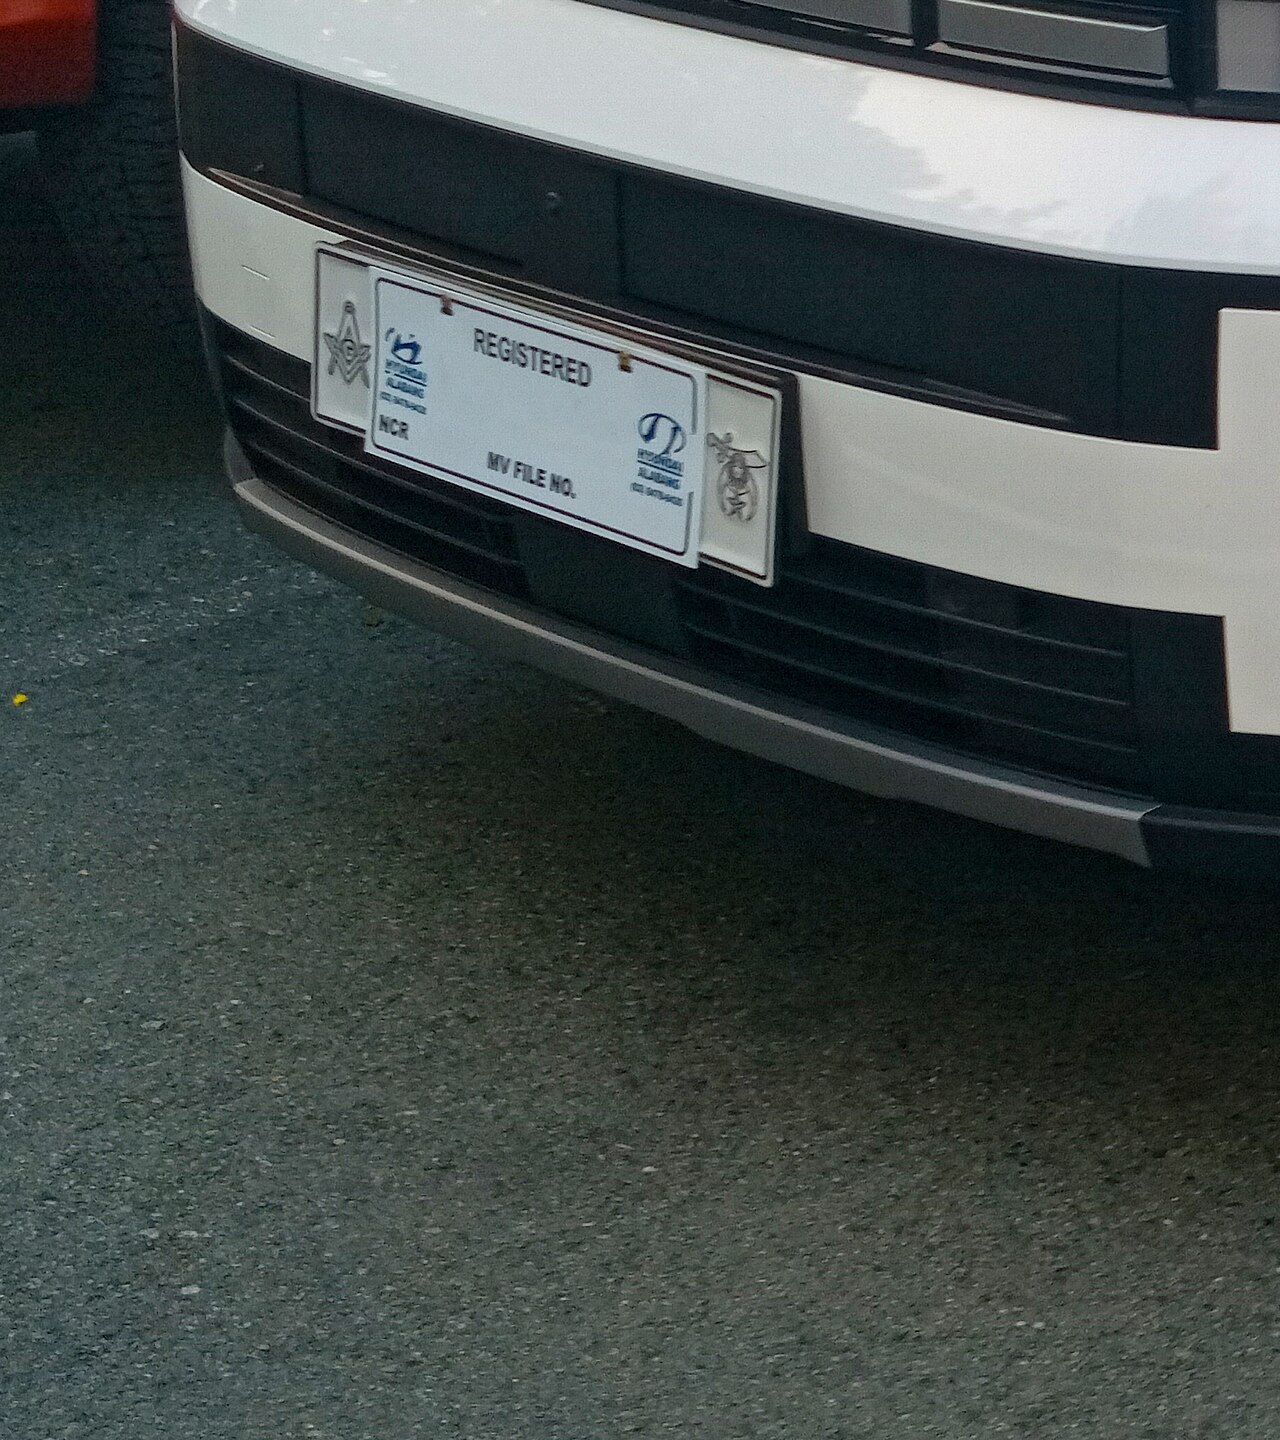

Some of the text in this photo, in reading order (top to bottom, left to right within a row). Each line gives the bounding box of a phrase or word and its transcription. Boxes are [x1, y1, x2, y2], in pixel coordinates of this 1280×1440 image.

[474, 327, 592, 388] REGISTERED
[379, 414, 409, 441] NCR
[487, 452, 577, 500] MV FILE NO.
